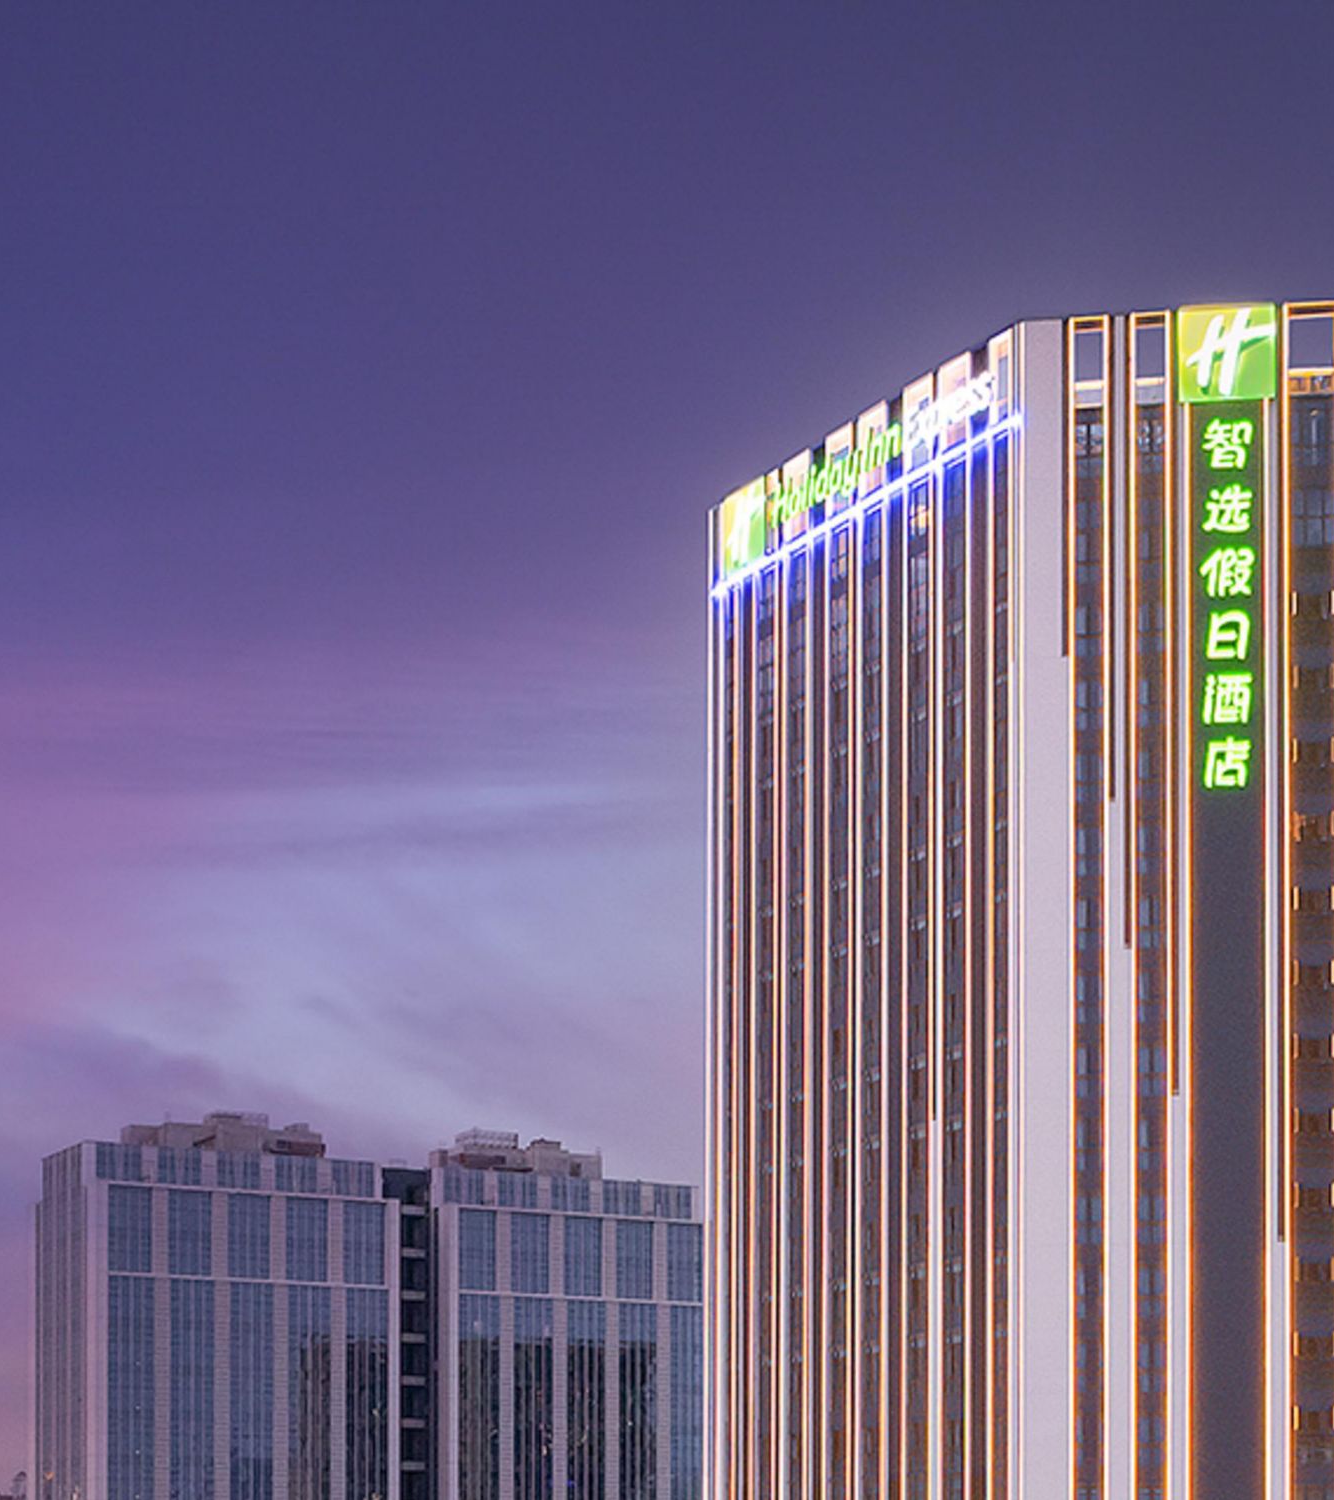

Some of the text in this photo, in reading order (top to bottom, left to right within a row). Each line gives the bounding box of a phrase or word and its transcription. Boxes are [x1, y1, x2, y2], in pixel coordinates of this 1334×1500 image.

[770, 449, 862, 529] Holiday
[862, 421, 903, 473] Inn
[1199, 417, 1255, 789] 智选假日酒店
